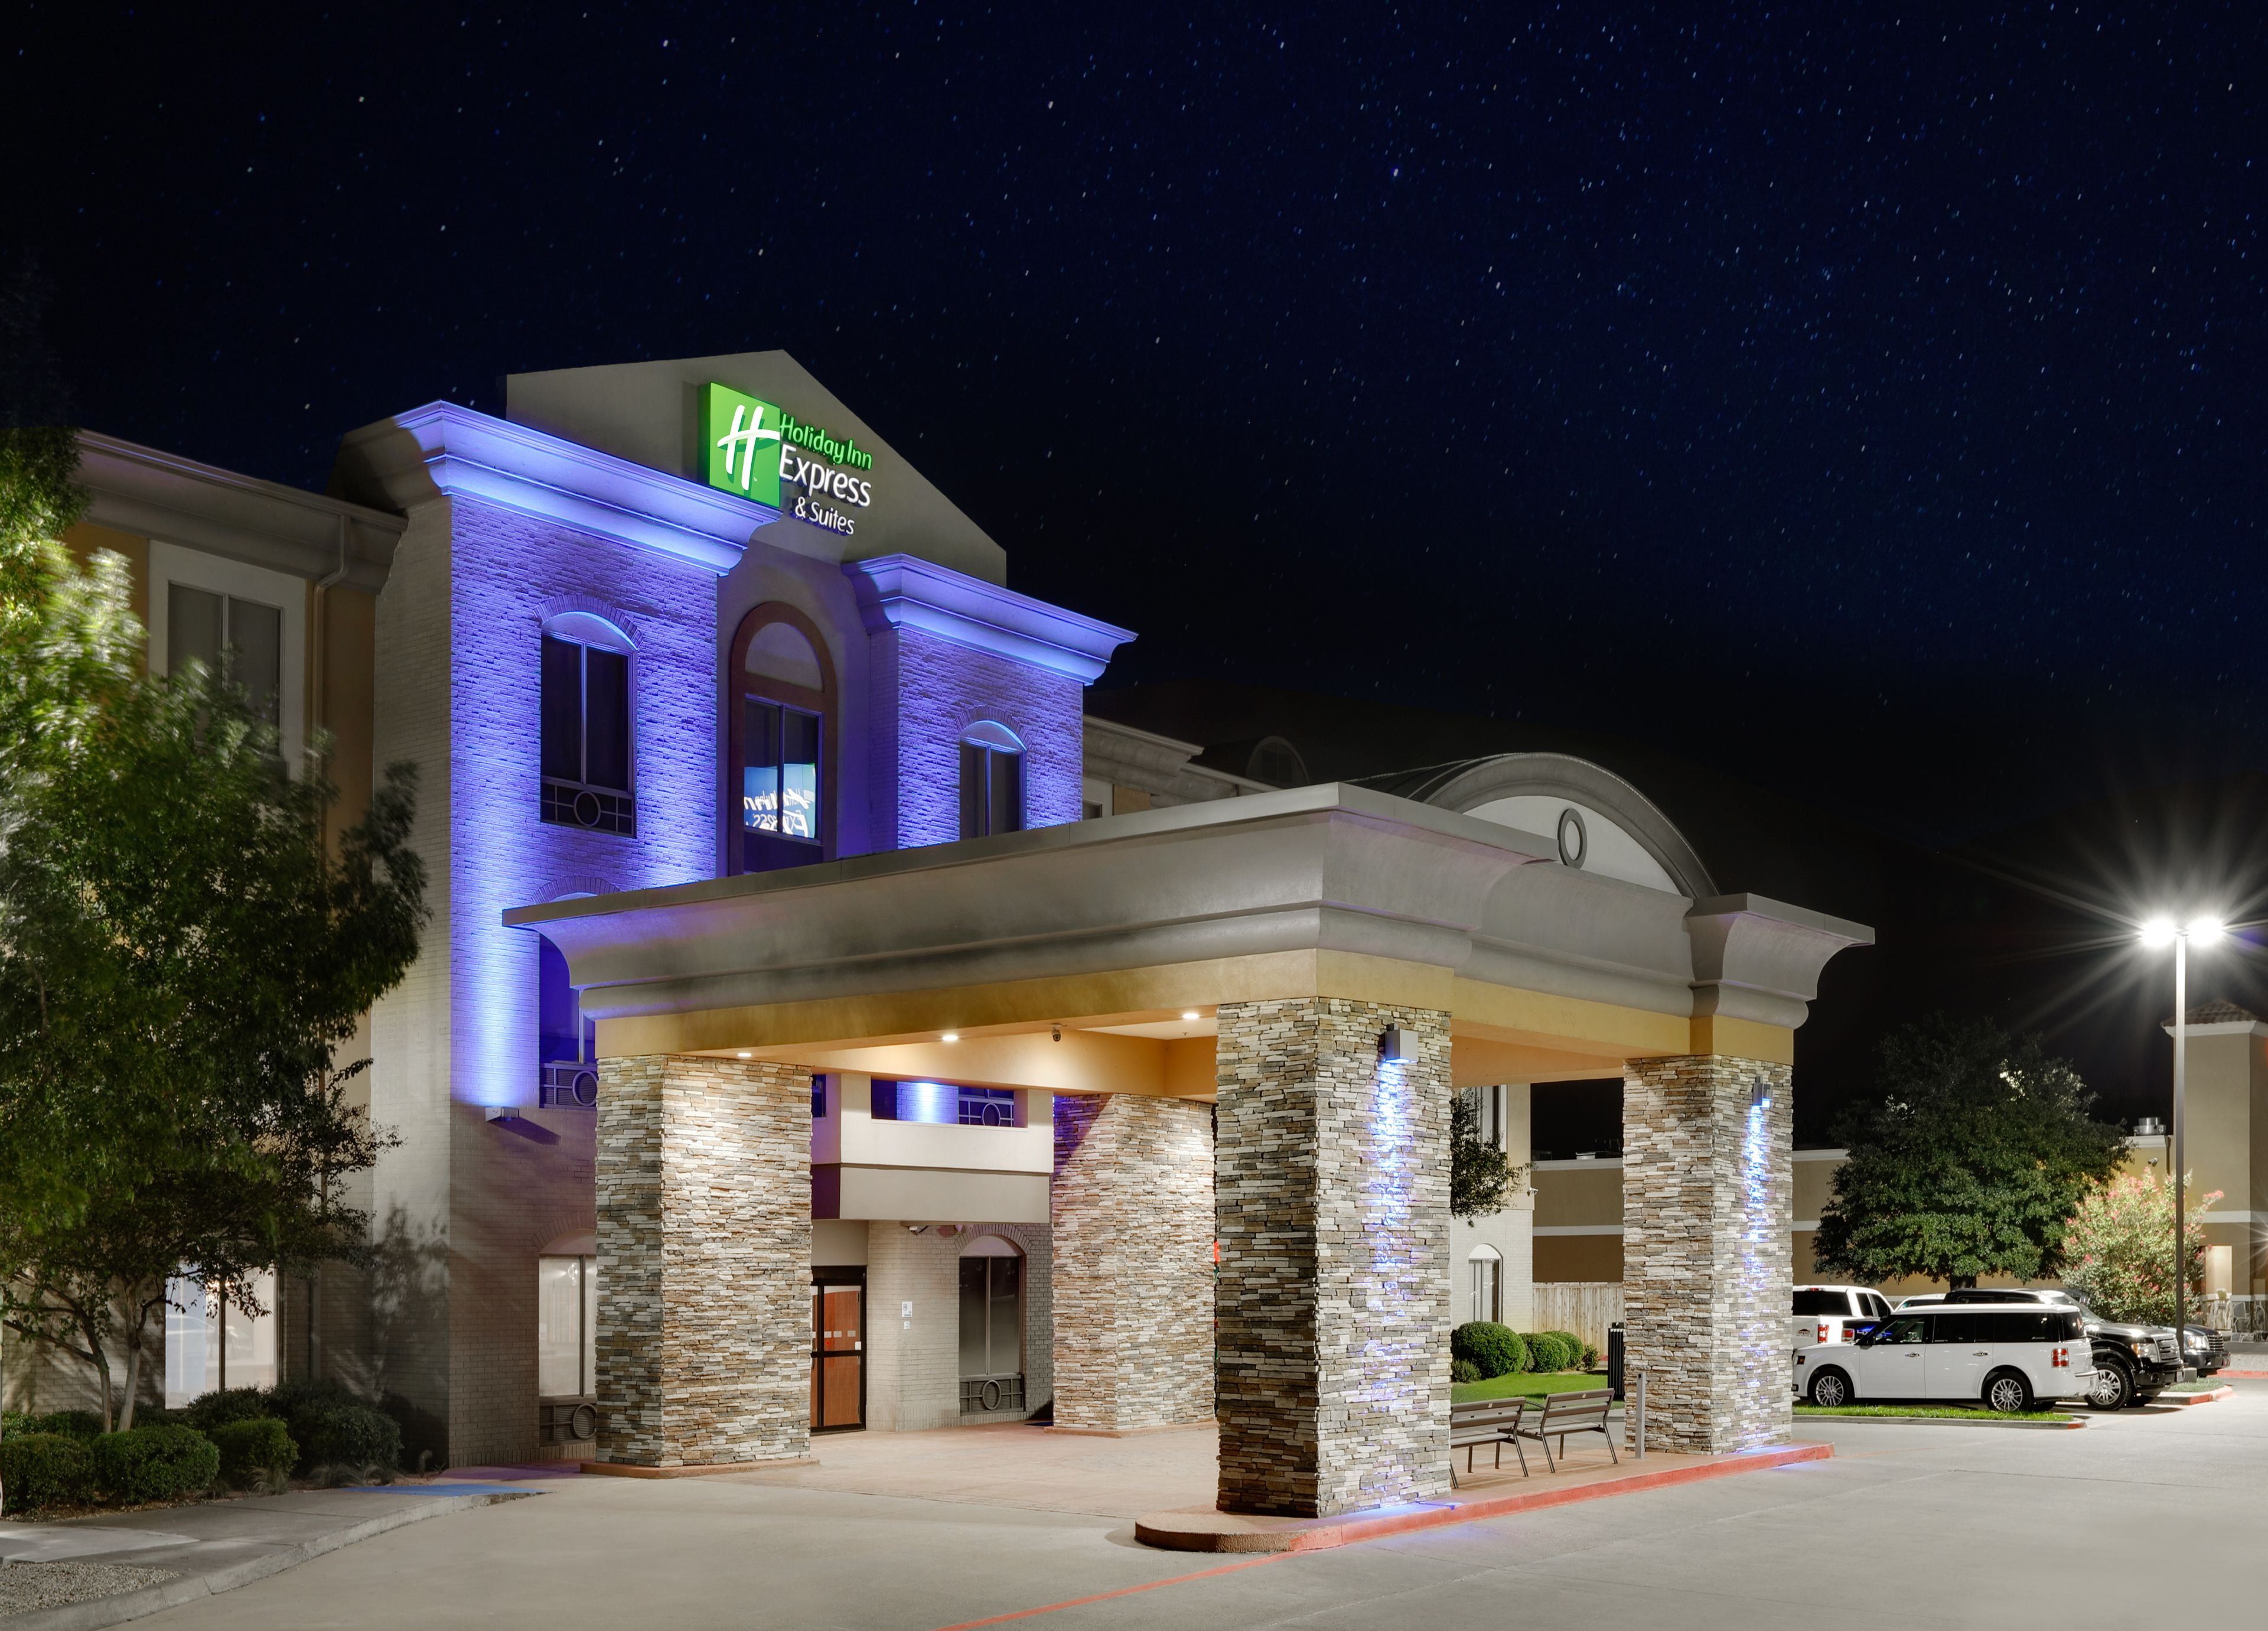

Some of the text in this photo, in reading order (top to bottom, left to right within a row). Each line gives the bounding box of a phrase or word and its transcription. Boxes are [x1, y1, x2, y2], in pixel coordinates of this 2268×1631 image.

[780, 414, 872, 470] Holiday Inn
[779, 444, 872, 507] Express
[794, 496, 855, 535] & Suites
